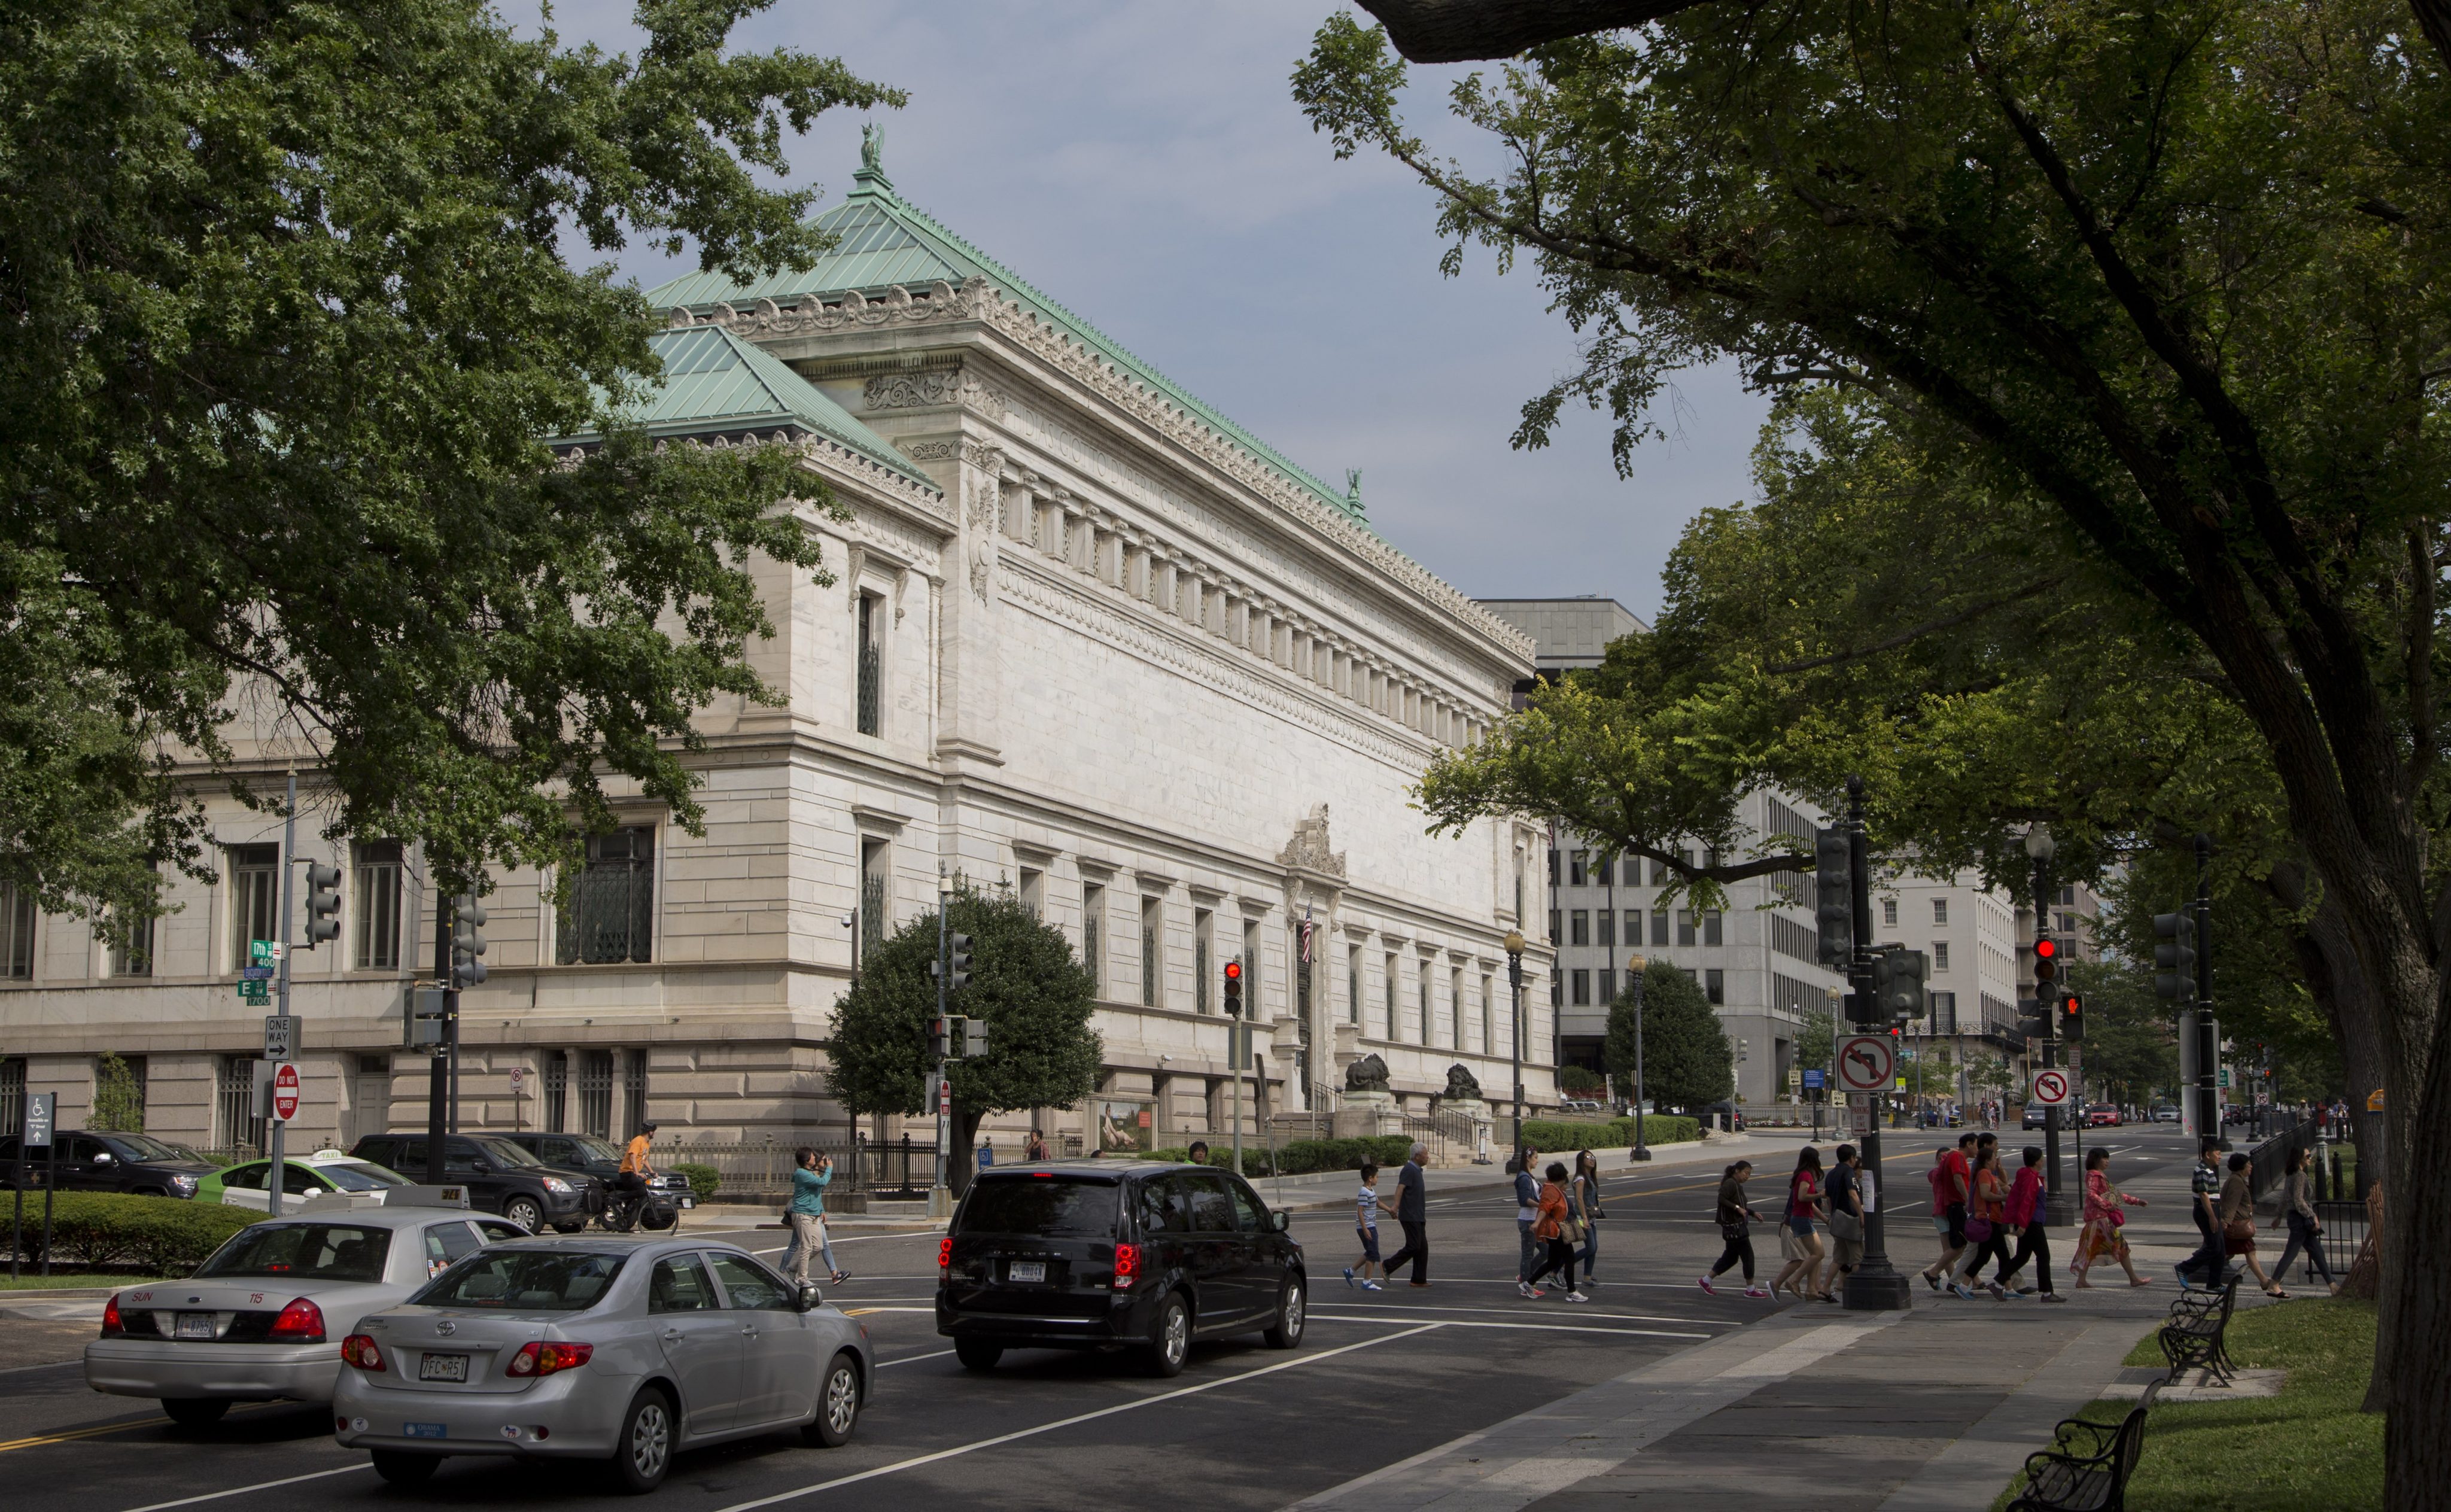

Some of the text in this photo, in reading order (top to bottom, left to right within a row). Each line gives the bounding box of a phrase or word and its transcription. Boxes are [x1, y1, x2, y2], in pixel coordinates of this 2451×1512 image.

[1006, 398, 1054, 450] PHIDIAS
[1059, 428, 1106, 479] GIOTTO
[1111, 458, 1147, 501] DVRER
[1235, 530, 1275, 573] RAPHAEL
[254, 942, 266, 956] 17th
[259, 958, 275, 967] 400
[242, 982, 251, 994] E
[248, 997, 270, 1005] 1700
[269, 1020, 288, 1030] ONE
[269, 1032, 288, 1042] WAY
[279, 1076, 295, 1084] DO NOT
[279, 1100, 293, 1109] ENTER
[1856, 1096, 1864, 1105] NO
[132, 1292, 153, 1302] SUN
[250, 1292, 264, 1304] 115
[190, 1321, 214, 1332] 87552
[423, 1360, 464, 1376] 7FC R51
